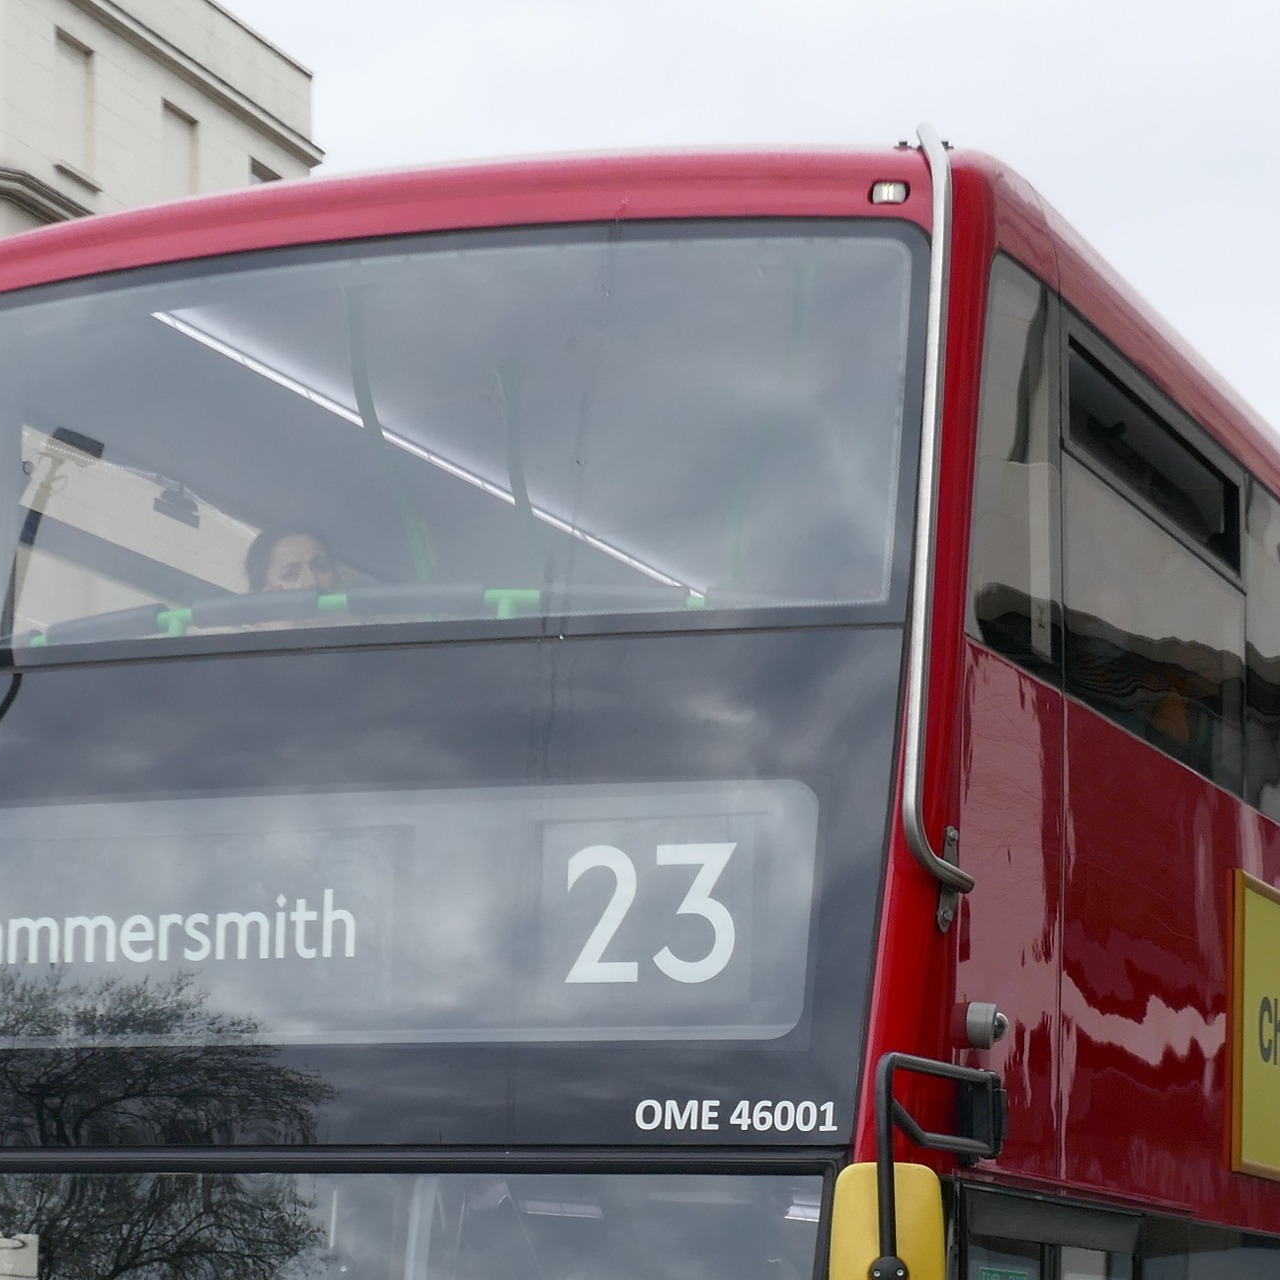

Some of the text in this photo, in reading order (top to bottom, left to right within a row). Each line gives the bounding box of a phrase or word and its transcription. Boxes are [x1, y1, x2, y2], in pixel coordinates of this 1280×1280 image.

[563, 840, 739, 984] 23
[634, 1098, 839, 1133] OME 46001
